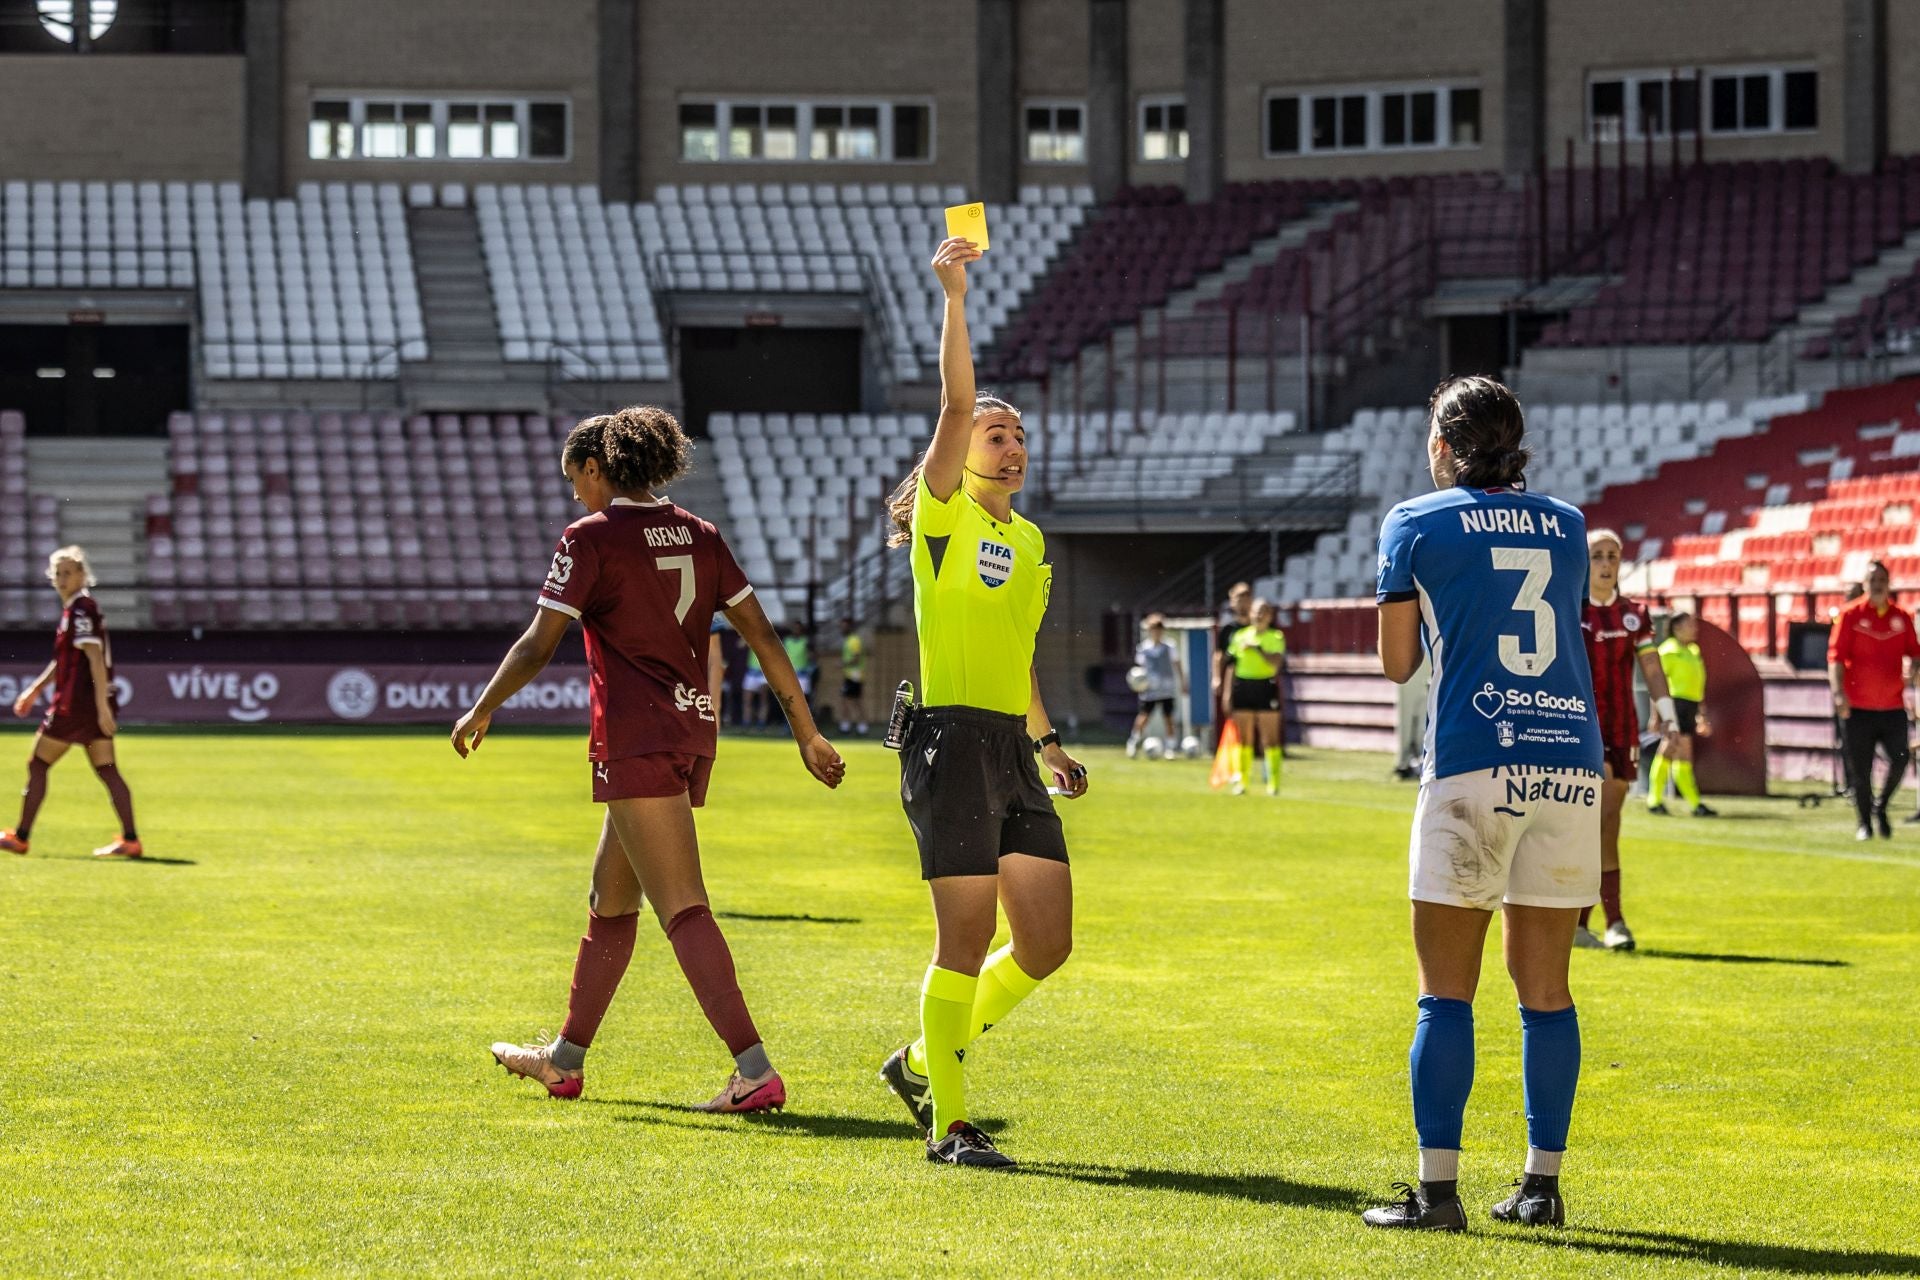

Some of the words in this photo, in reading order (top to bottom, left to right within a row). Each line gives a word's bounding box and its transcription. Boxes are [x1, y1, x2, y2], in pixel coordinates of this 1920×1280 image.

[1459, 508, 1535, 534] NURIA
[1540, 512, 1566, 538] M.
[643, 525, 693, 547] ASENJO
[981, 541, 1012, 560] FIFA
[979, 559, 1010, 574] REFEREE
[655, 554, 697, 626] 7
[984, 576, 1000, 586] 2025
[1490, 547, 1557, 677] 3
[385, 682, 450, 709] DUX
[1506, 689, 1532, 706] So
[1535, 690, 1587, 713] Goods
[1506, 707, 1535, 716] Spanish
[1536, 709, 1566, 719] Organics
[1567, 713, 1588, 722] Goods
[1517, 733, 1546, 743] Alhama
[1555, 736, 1580, 744] Murcia
[1526, 727, 1570, 736] AYUNTAMIENTO
[1505, 777, 1596, 807] Nature
